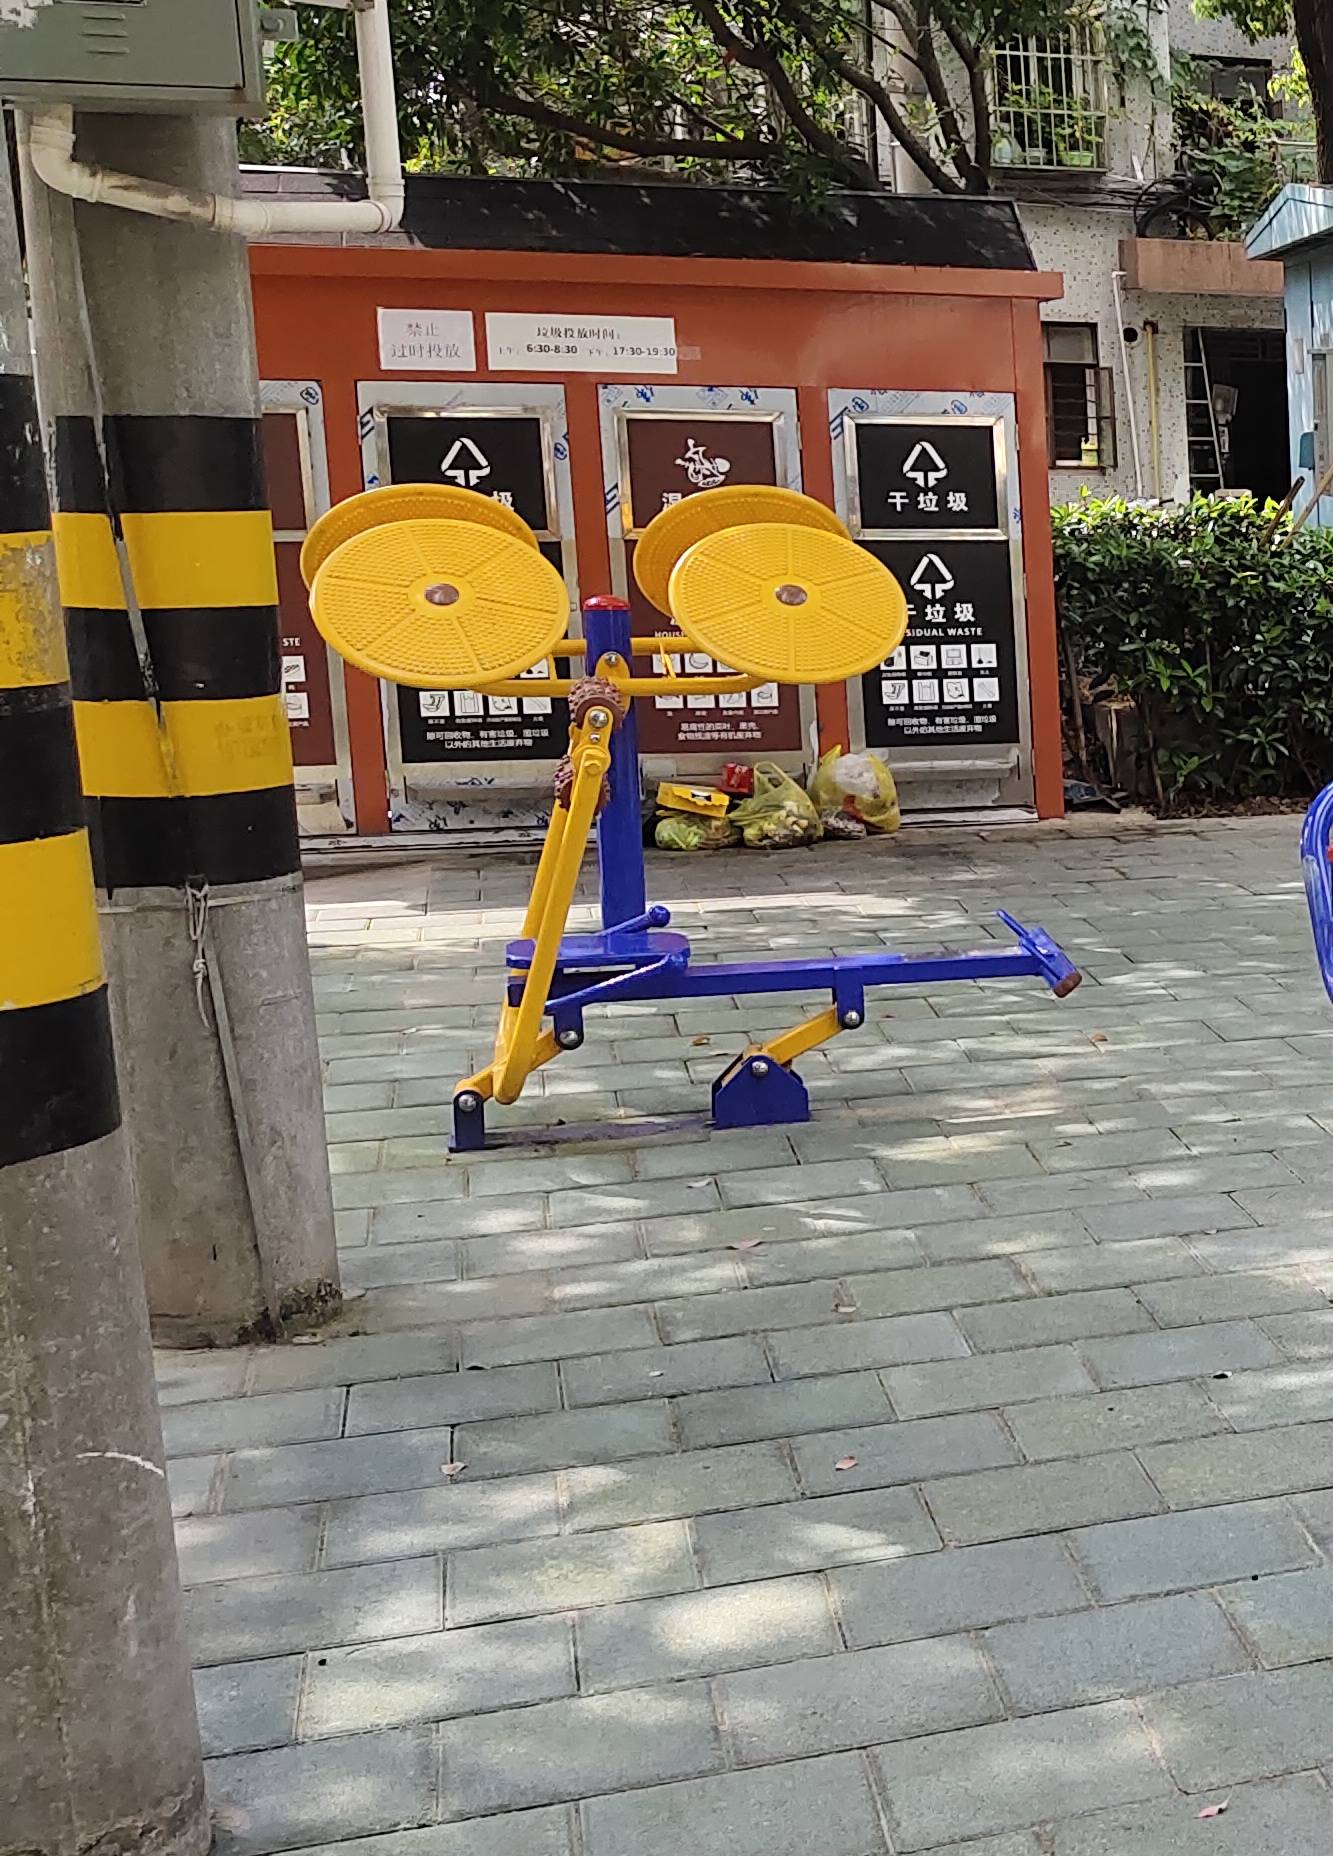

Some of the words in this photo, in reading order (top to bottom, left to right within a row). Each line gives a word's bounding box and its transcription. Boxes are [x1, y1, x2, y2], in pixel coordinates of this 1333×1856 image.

[405, 322, 439, 337] 禁止
[391, 343, 461, 358] 过时投放
[526, 343, 578, 354] 6:30-8:30
[613, 347, 676, 357] 17:30-19:30
[887, 491, 969, 512] 干垃圾
[905, 628, 944, 637] SIDUAL
[947, 627, 983, 636] WASTE
[282, 637, 301, 647] STE
